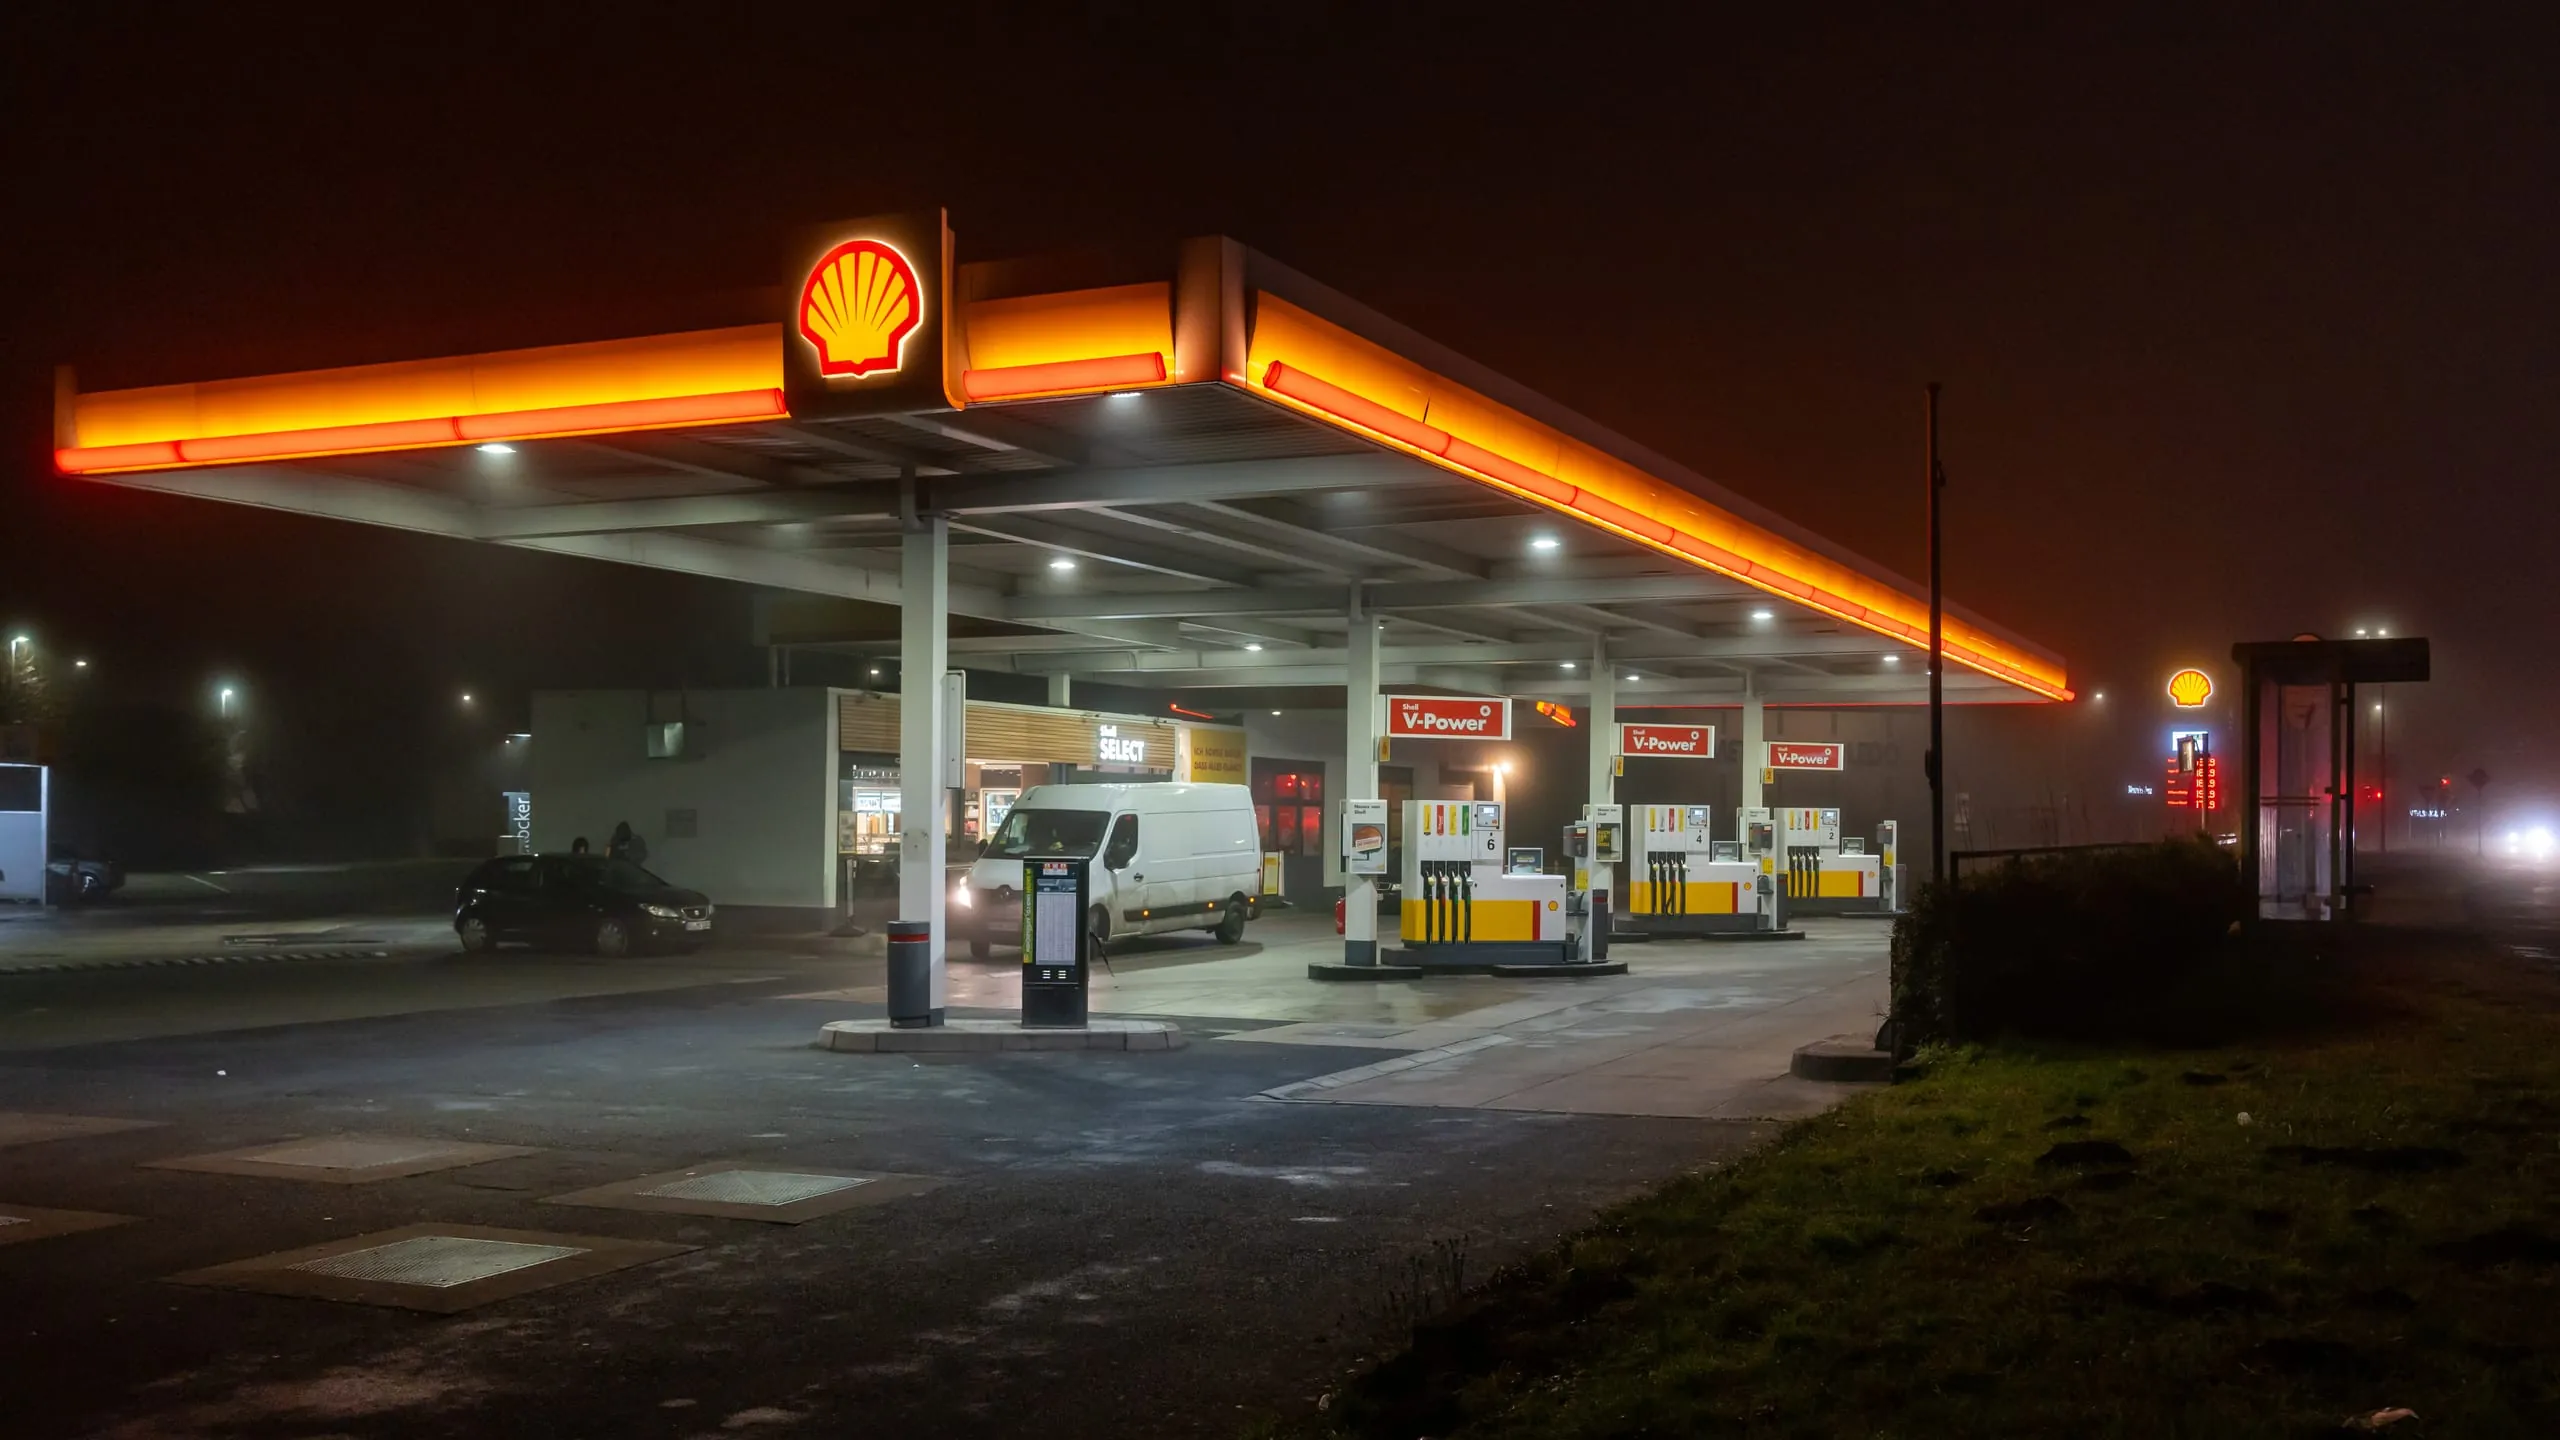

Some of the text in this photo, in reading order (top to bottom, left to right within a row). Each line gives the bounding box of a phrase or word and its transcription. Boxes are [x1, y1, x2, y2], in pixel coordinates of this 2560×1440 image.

[1402, 703, 1419, 711] Shell
[1402, 712, 1487, 731] V-Power
[1100, 738, 1144, 762] SELECT
[1633, 737, 1696, 751] V-Power
[1778, 752, 1829, 765] V-Power
[1696, 834, 1702, 844] 4
[1829, 832, 1834, 840] 2
[1487, 838, 1495, 850] 6
